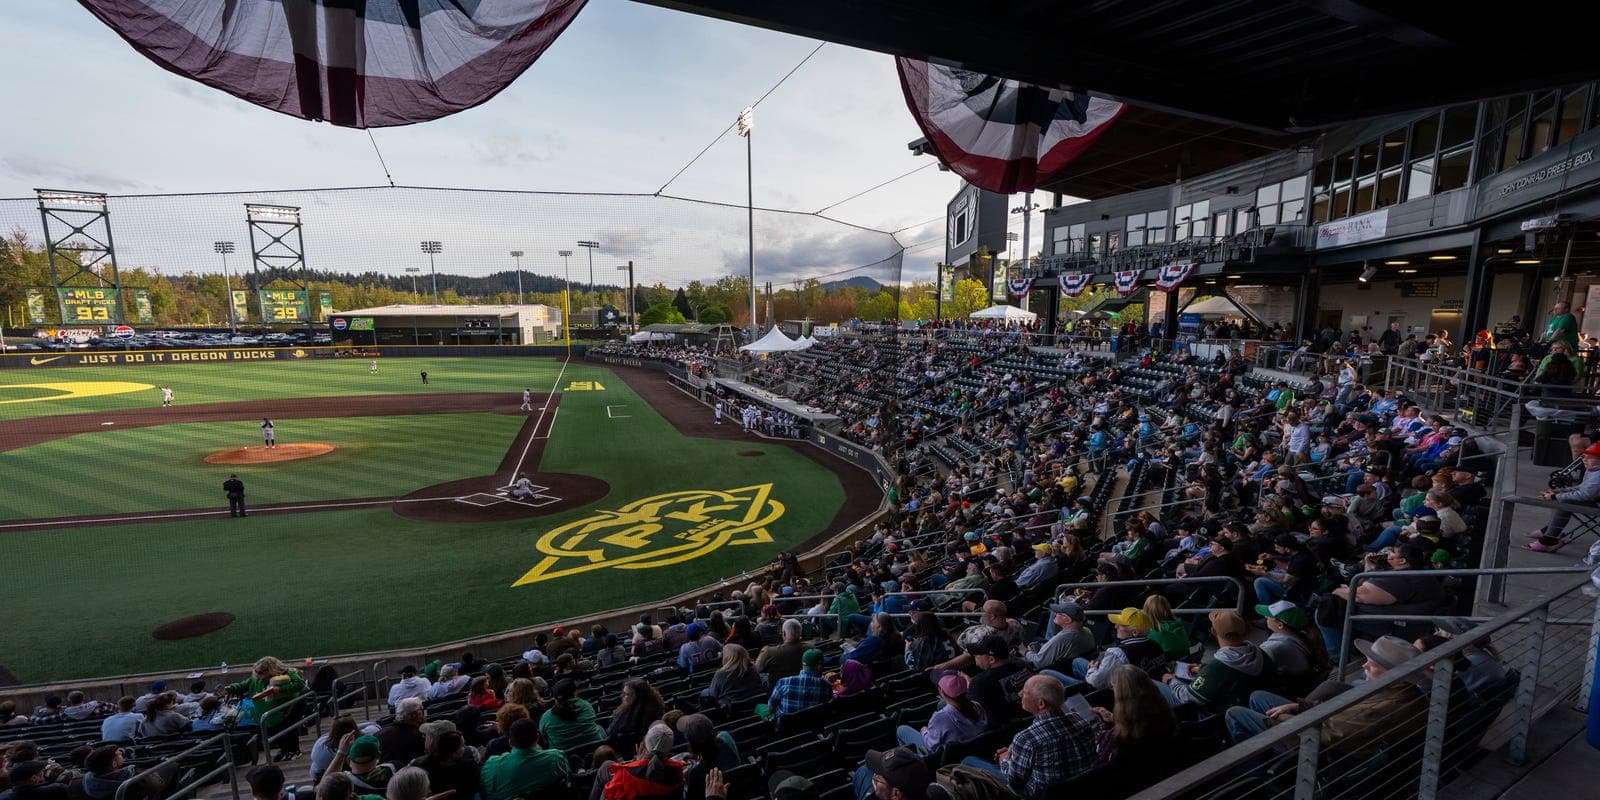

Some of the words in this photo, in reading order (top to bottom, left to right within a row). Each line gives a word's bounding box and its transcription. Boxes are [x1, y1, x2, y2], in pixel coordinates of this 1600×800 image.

[1574, 149, 1594, 167] BOX
[74, 291, 104, 299] MLB
[272, 292, 295, 300] MLB
[77, 307, 108, 320] 93
[273, 307, 298, 319] 39
[80, 354, 117, 364] JUST
[126, 354, 145, 363] DO
[152, 353, 165, 362] IT
[171, 351, 227, 361] OREGON
[234, 350, 275, 359] DUCKS
[673, 519, 726, 540] PARK
